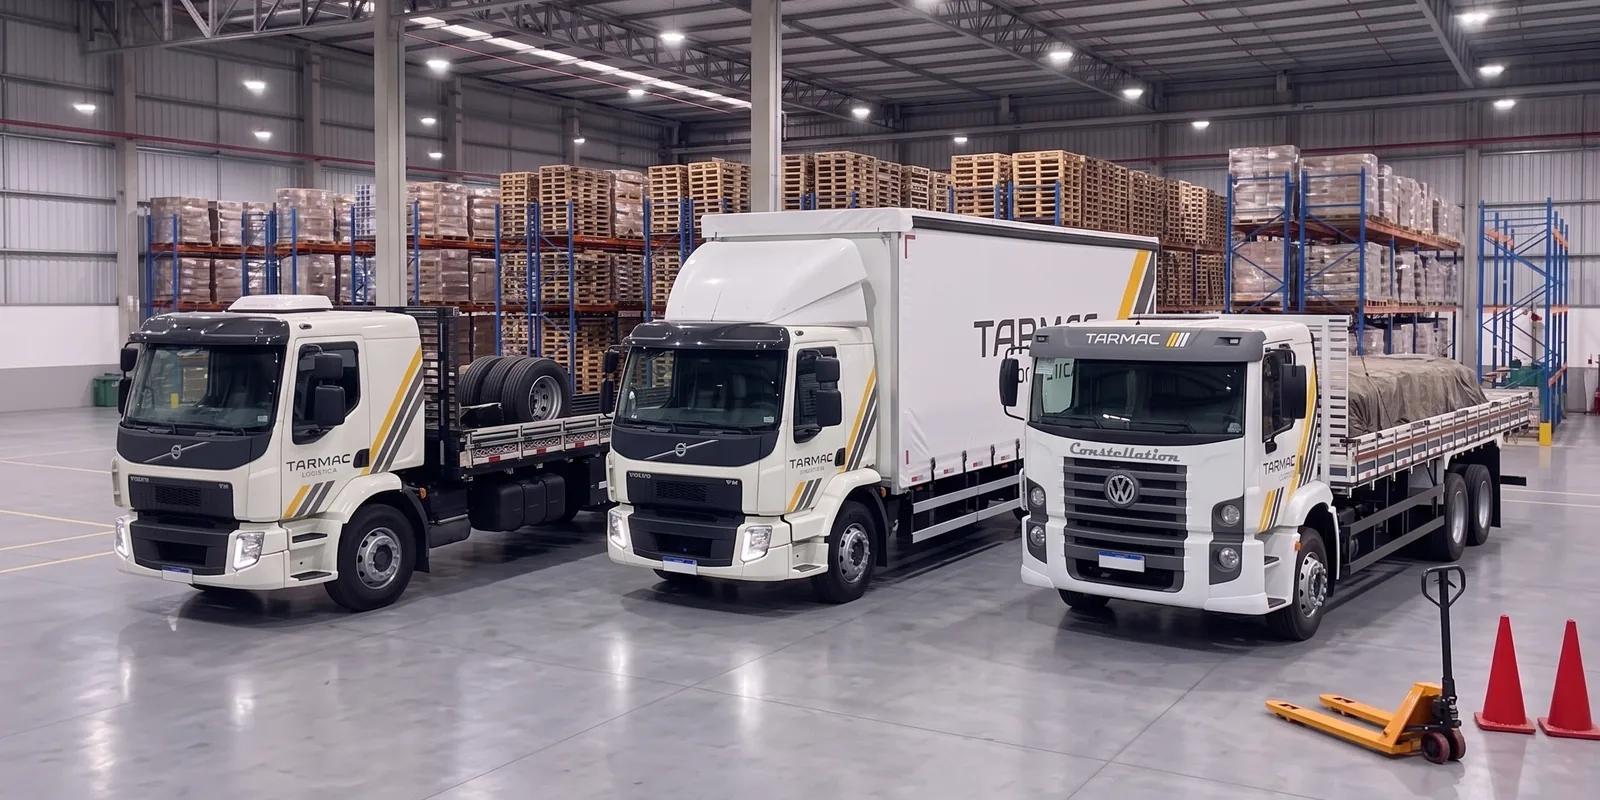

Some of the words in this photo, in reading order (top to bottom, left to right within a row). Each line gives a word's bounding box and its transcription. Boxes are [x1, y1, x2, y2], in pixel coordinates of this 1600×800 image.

[1086, 333, 1160, 345] TARMAC
[789, 452, 833, 469] TARMAC
[1070, 442, 1180, 462] Constellation
[285, 453, 351, 472] TARMAC
[1263, 455, 1296, 475] TARMAC
[301, 468, 338, 478] LOGISTICA
[629, 472, 652, 480] VOLVO
